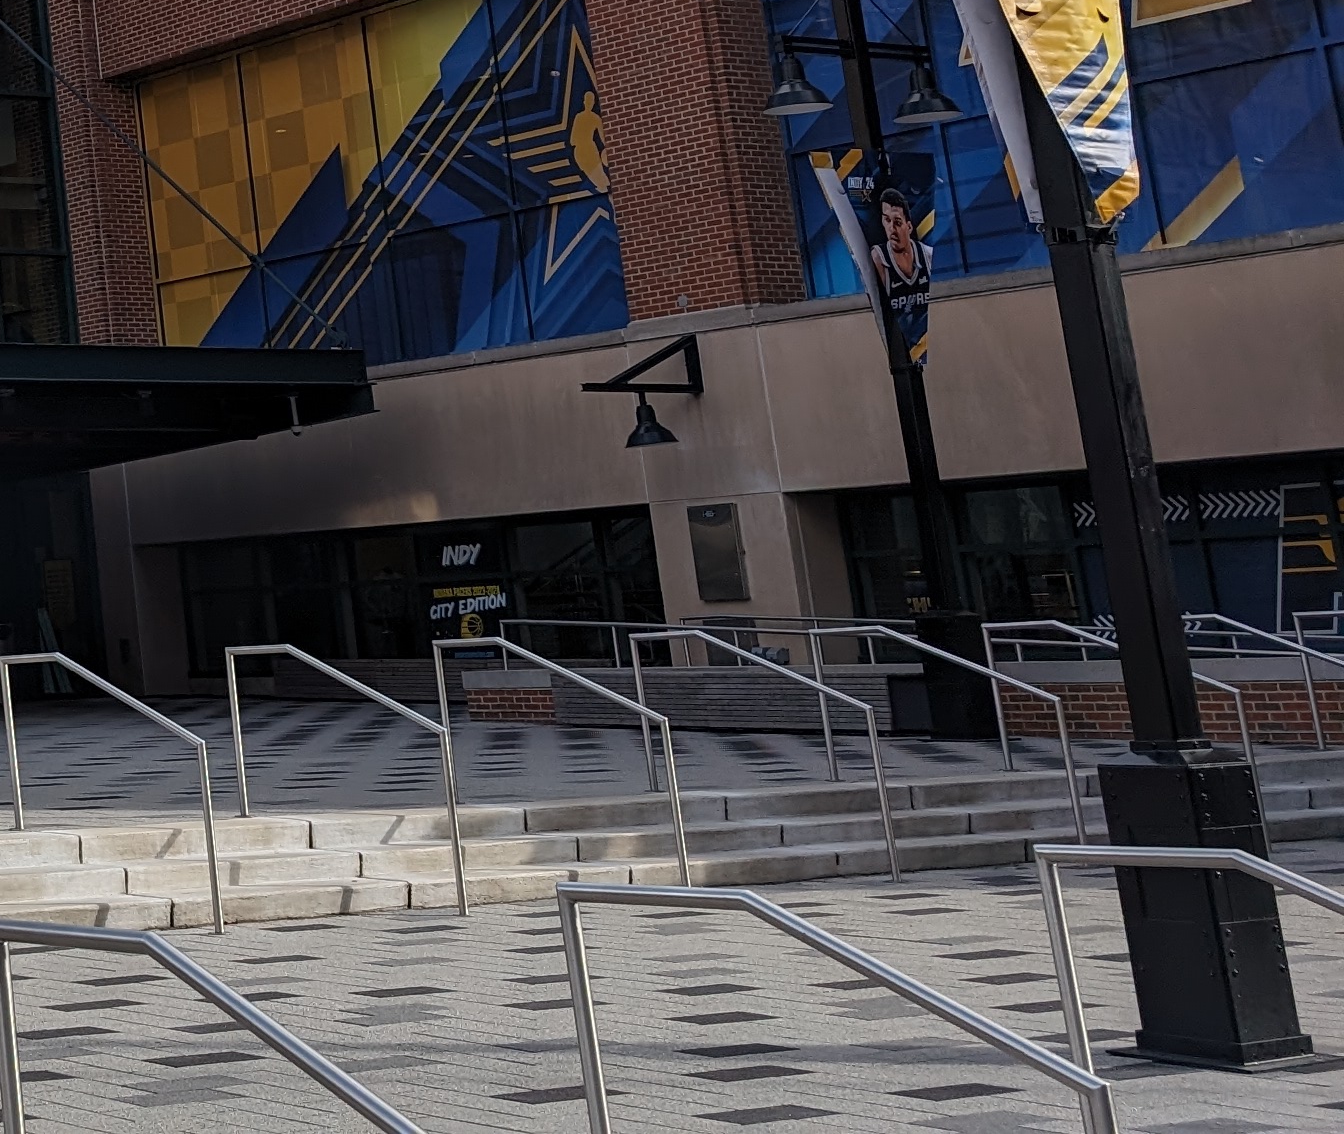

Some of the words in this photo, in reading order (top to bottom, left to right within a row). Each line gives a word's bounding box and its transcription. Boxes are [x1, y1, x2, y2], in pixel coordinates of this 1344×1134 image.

[442, 543, 481, 567] INDY
[429, 601, 456, 620] CITY
[457, 592, 507, 615] EDITION
